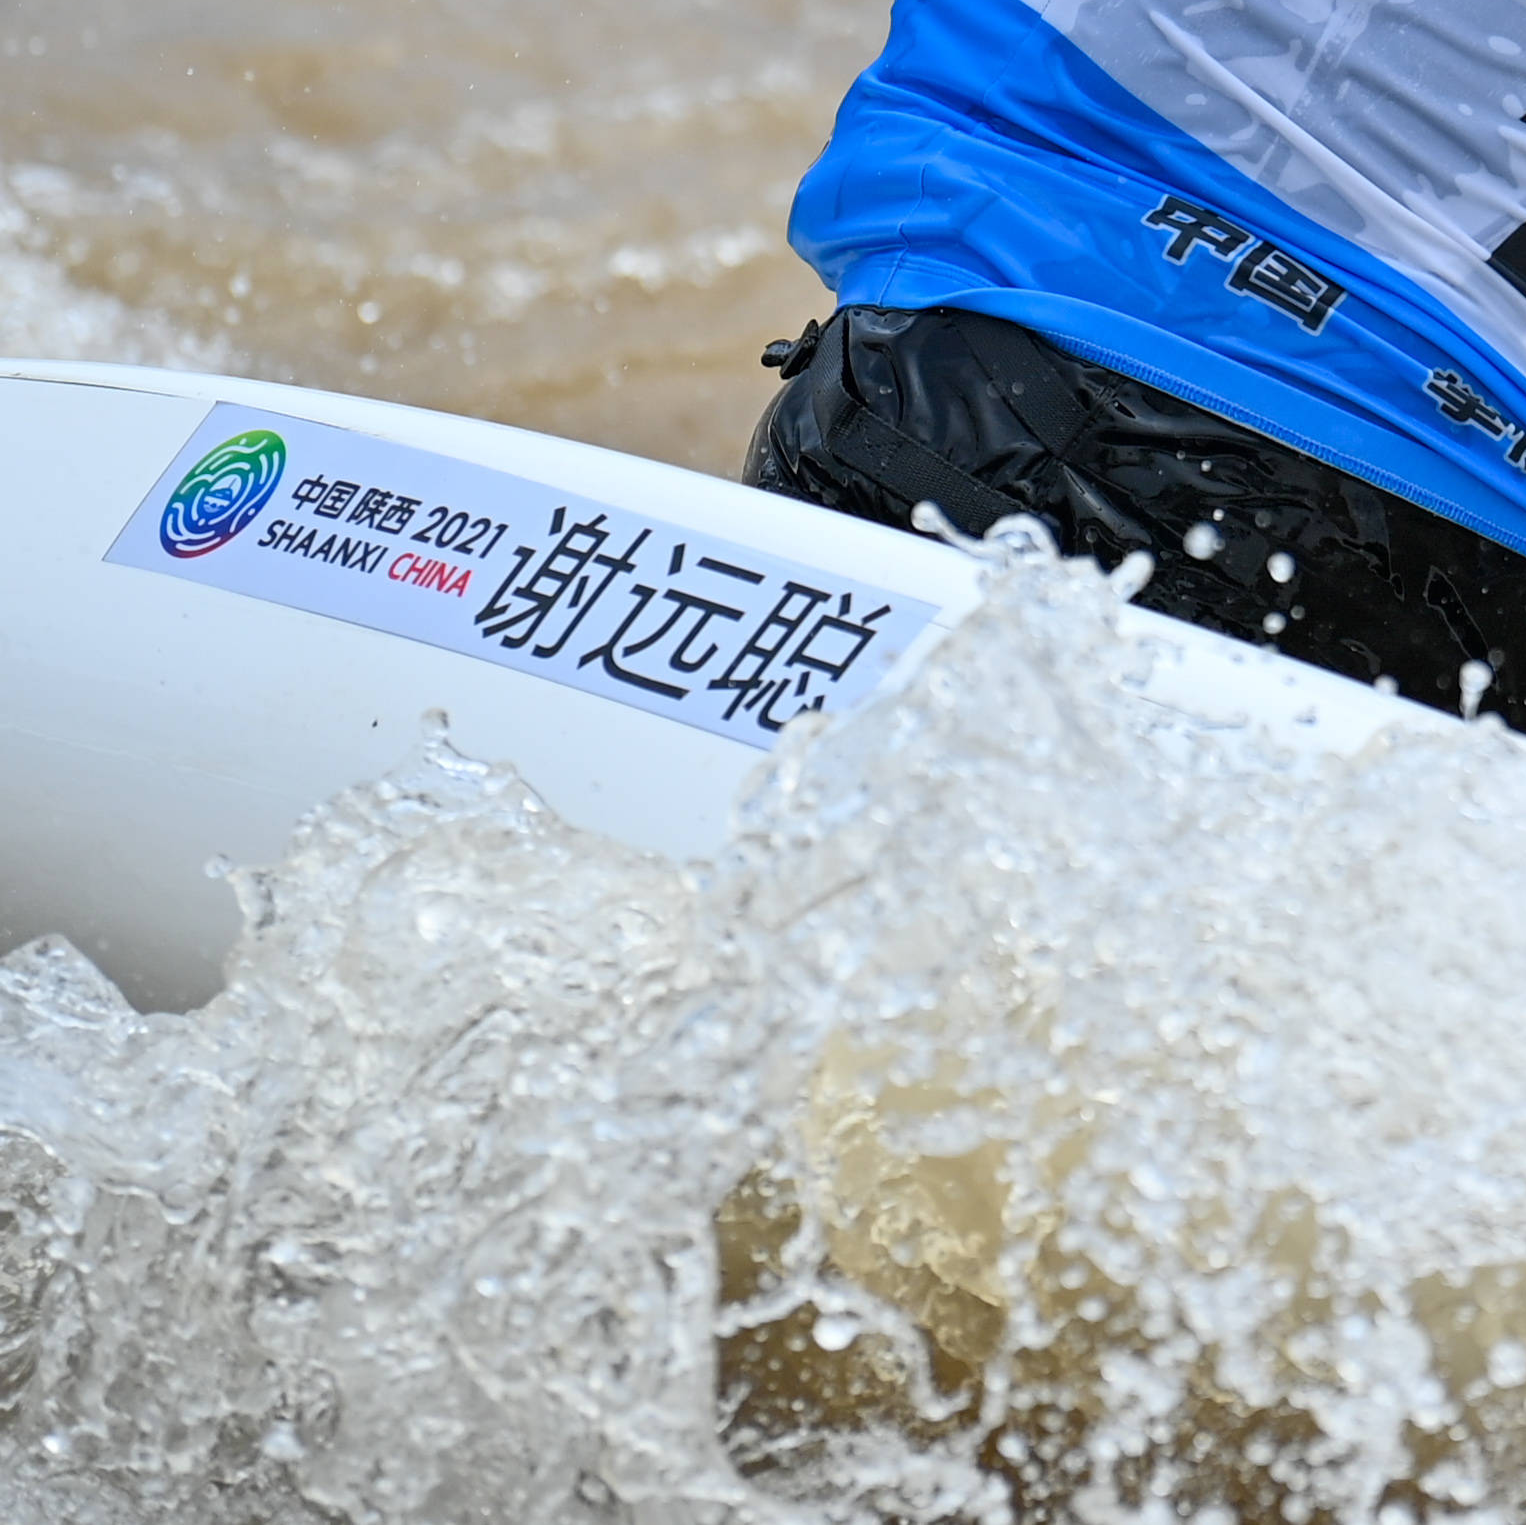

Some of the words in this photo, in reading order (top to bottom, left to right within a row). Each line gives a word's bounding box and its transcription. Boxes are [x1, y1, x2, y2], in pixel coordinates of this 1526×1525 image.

[257, 519, 389, 574] SHAANXI
[387, 552, 473, 598] CHINA
[410, 506, 510, 559] 2021
[474, 506, 892, 733] 谢远聪
